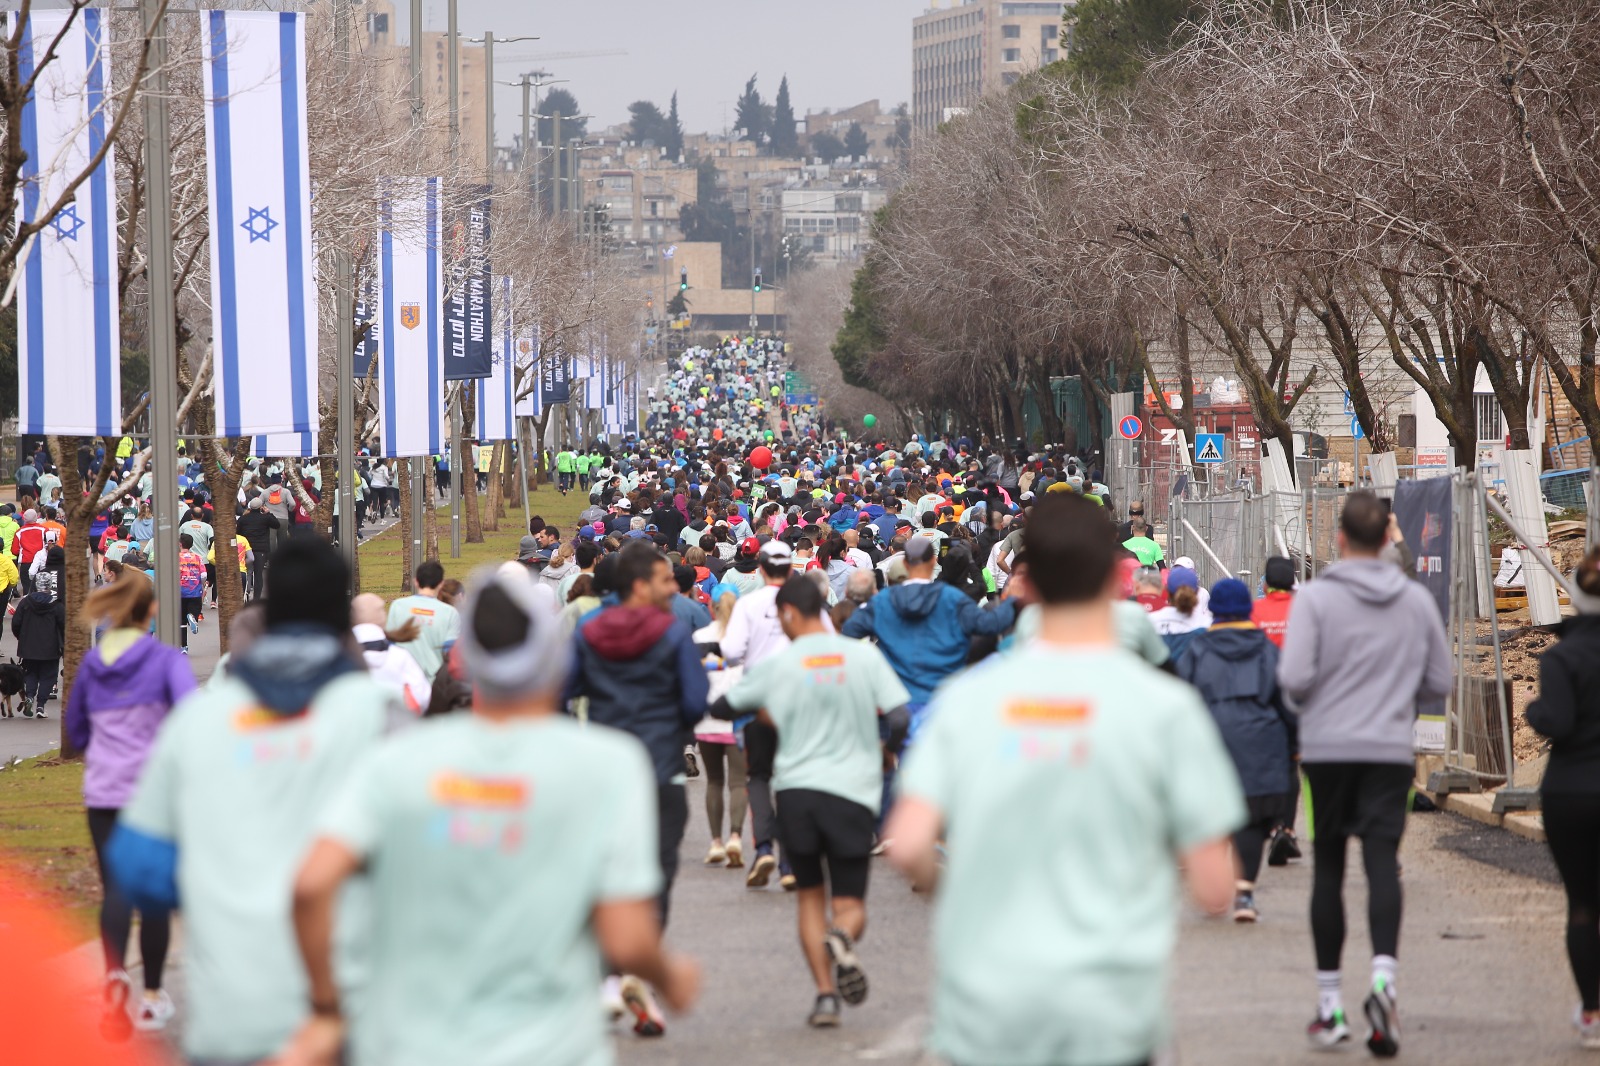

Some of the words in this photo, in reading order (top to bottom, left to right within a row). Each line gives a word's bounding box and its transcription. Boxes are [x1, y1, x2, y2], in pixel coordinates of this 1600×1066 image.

[470, 278, 484, 342] MARATHON
[449, 318, 465, 358] מרתון
[50, 570, 58, 588] NIKE
